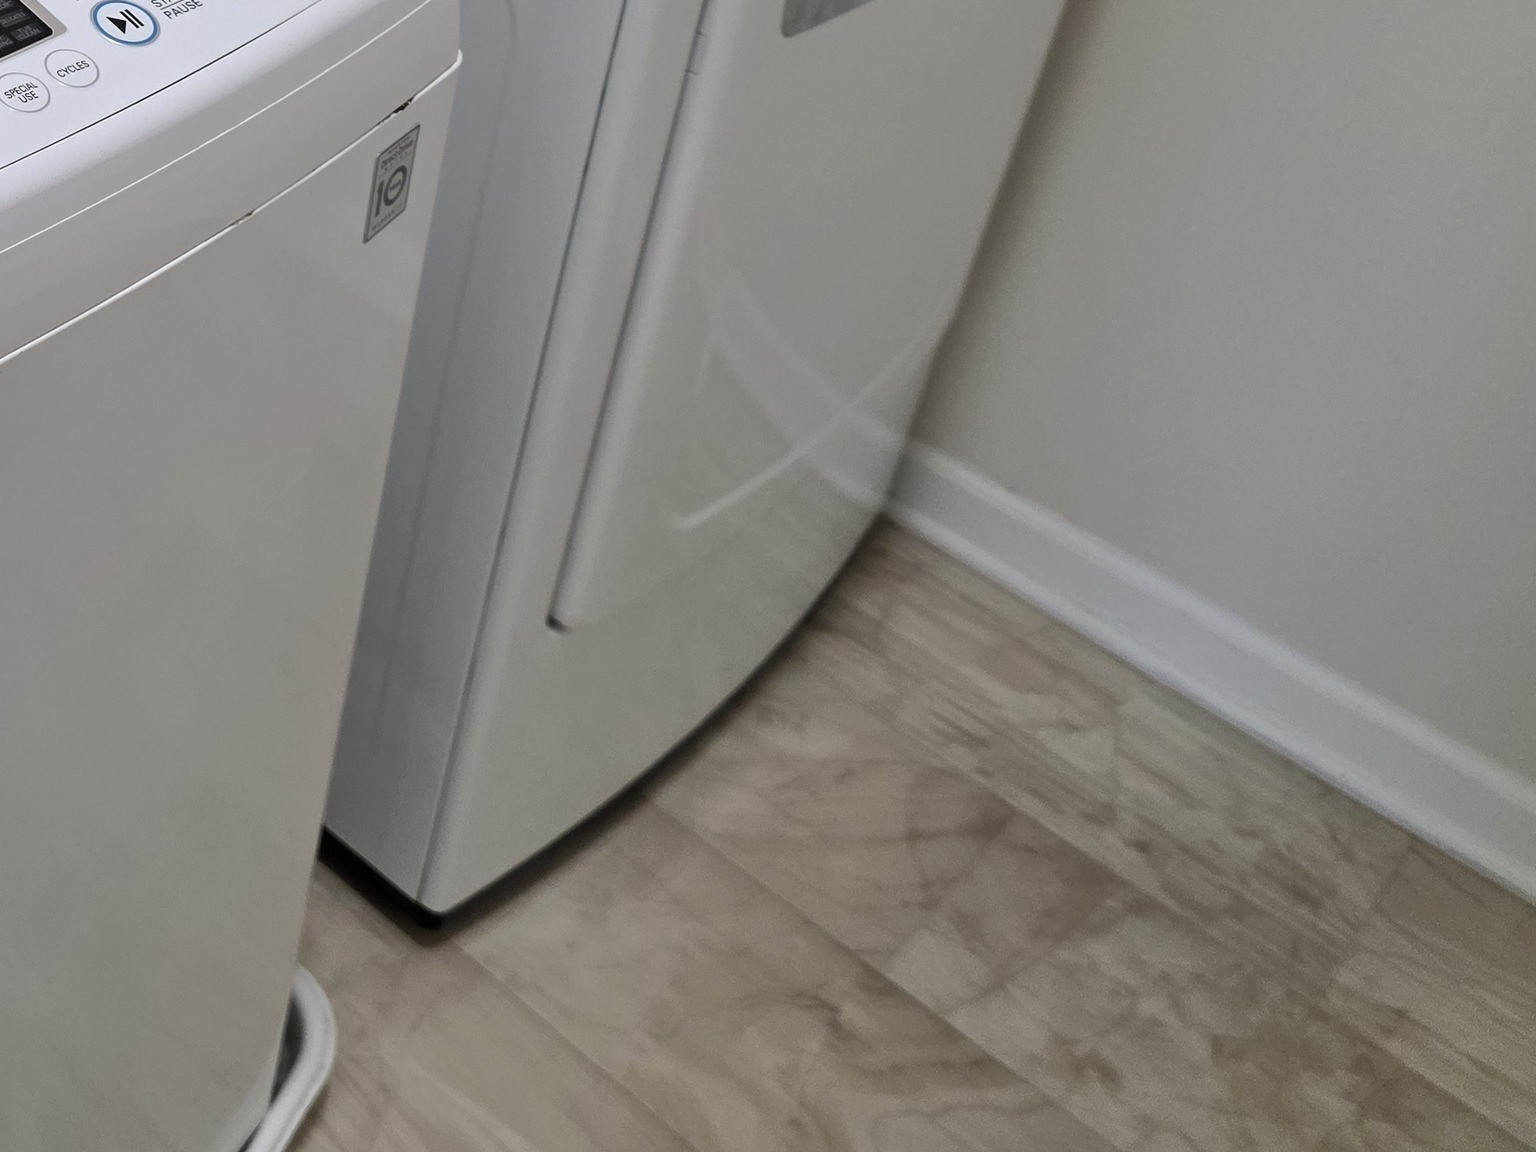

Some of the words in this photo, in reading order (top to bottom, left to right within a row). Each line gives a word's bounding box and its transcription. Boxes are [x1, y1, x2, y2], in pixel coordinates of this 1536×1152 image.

[57, 60, 90, 78] CYCLES
[4, 81, 38, 100] SPECIAL
[18, 90, 39, 104] USE
